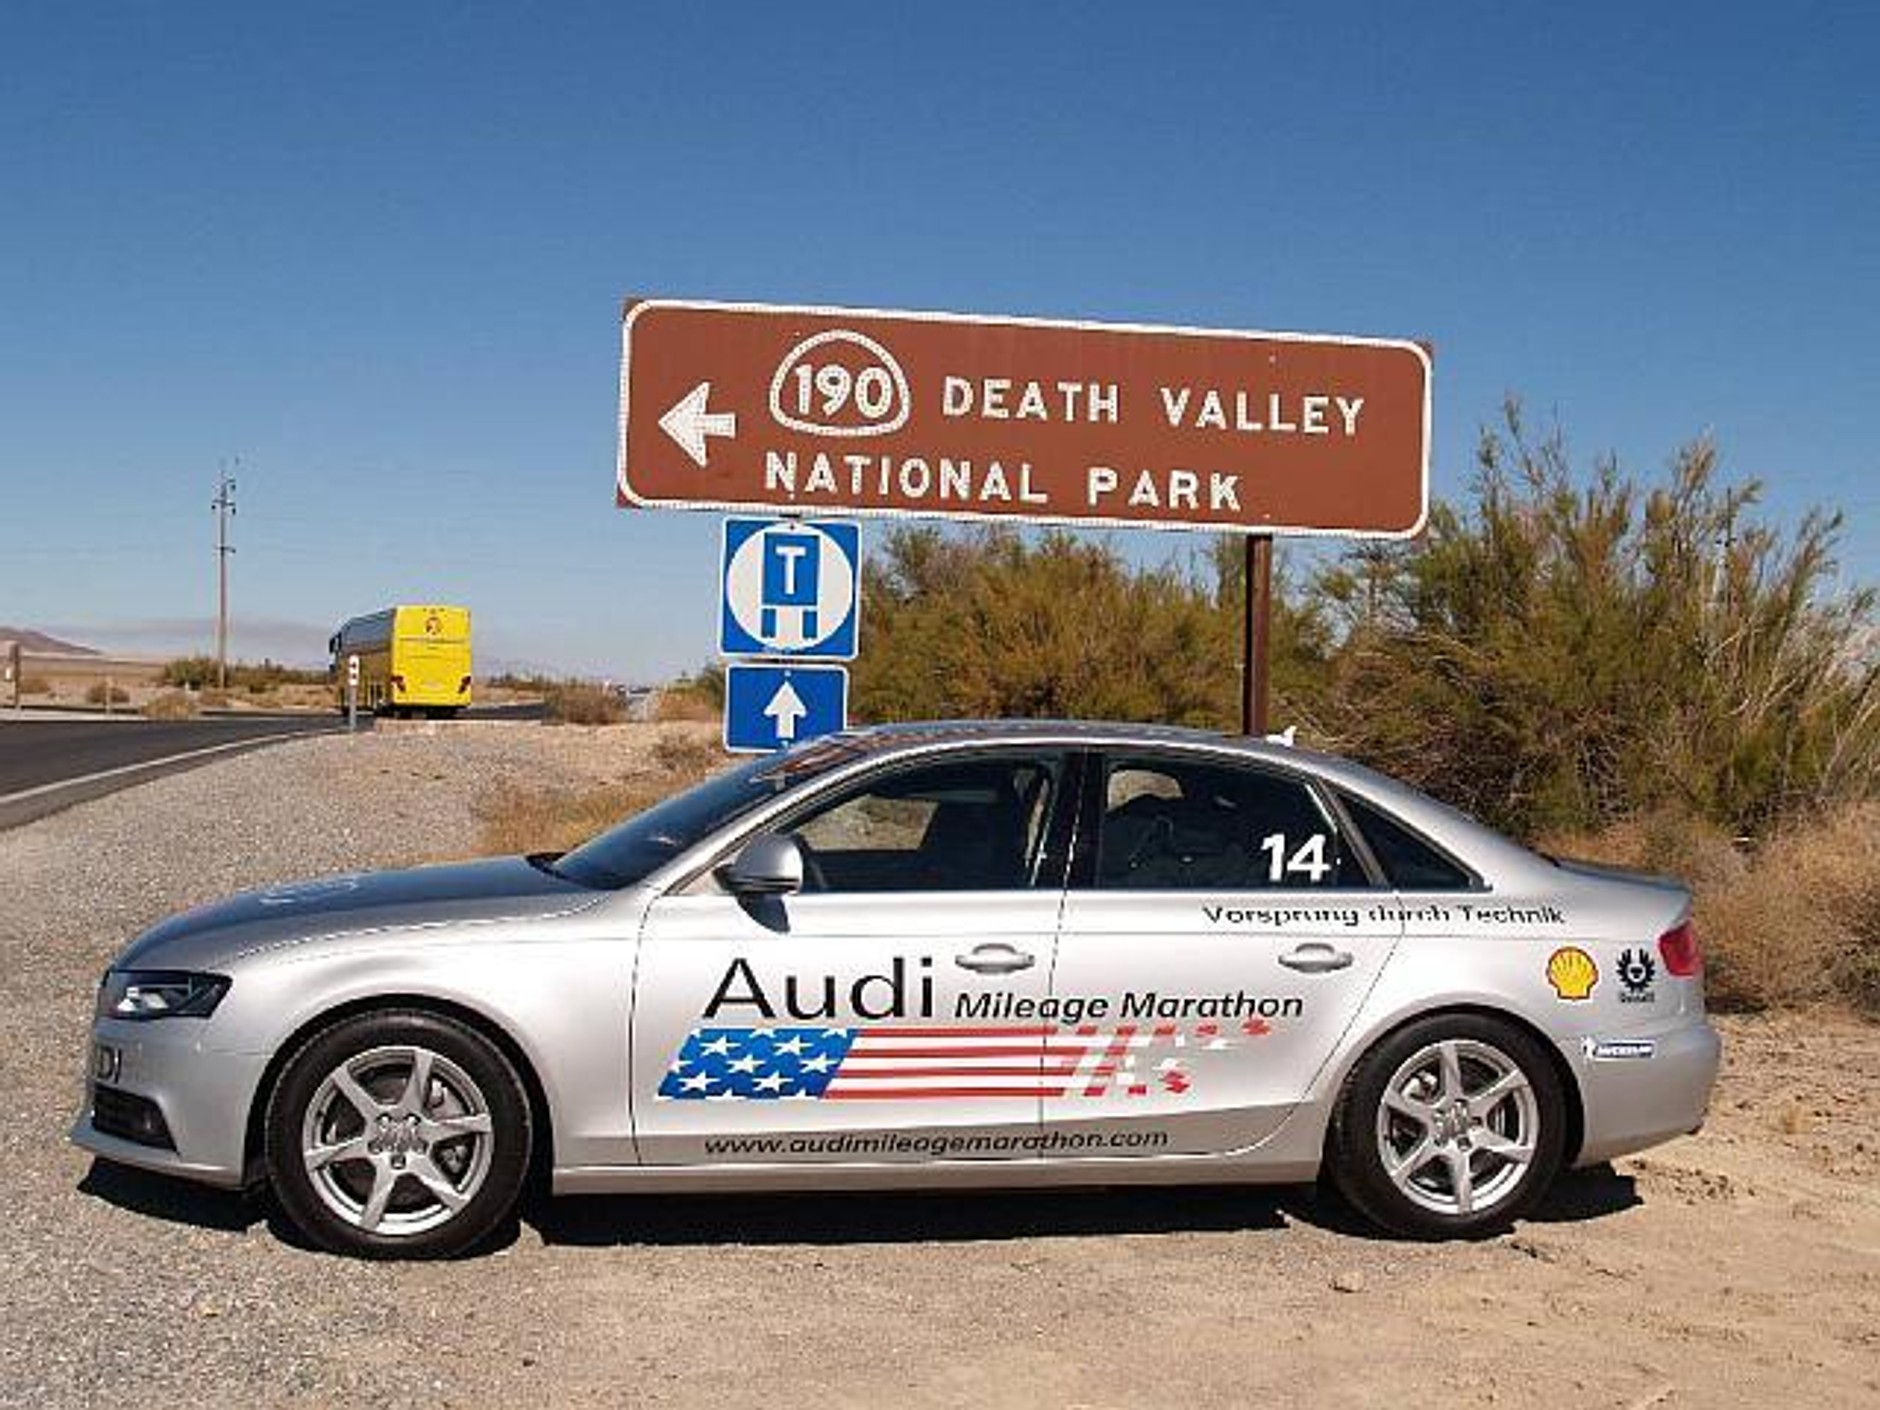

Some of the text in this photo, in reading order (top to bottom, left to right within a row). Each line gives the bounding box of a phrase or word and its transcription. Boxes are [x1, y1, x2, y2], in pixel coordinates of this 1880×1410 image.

[795, 364, 1364, 436] 190 DEATH VALLEY
[765, 451, 1241, 511] NATIONAL PARK
[774, 546, 807, 595] T
[1260, 833, 1331, 882] 14
[1202, 904, 1565, 926] Vorsprung durch Technik
[702, 956, 933, 1020] Audi
[954, 990, 1303, 1022] Mileage Marathon
[703, 1127, 1168, 1157] www.audimileagemarathon.com
